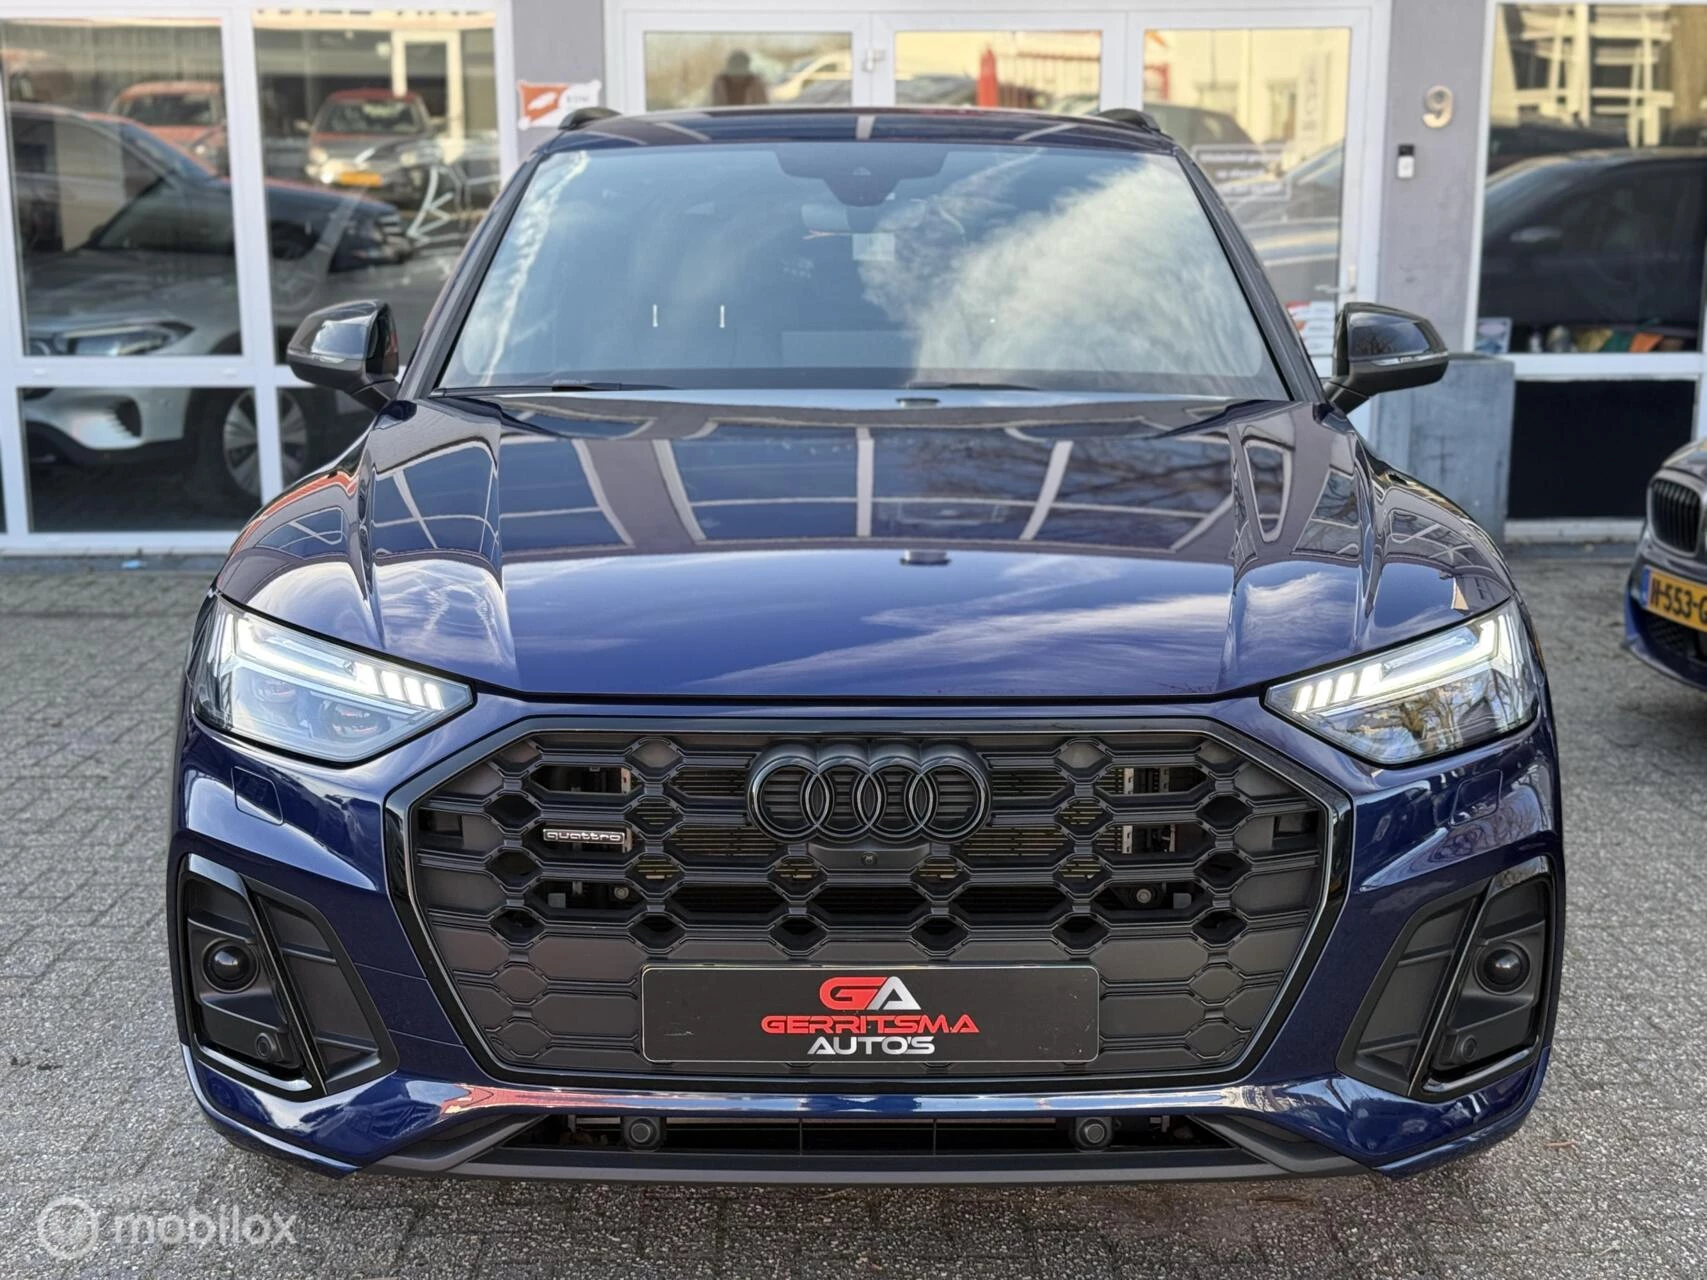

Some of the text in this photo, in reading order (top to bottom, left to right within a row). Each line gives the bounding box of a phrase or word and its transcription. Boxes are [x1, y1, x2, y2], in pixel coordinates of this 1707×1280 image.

[1423, 85, 1453, 128] 9
[546, 831, 622, 841] quattro
[819, 976, 921, 1010] GA
[761, 1014, 980, 1034] GERRITSMA
[807, 1036, 936, 1055] AUTO'S
